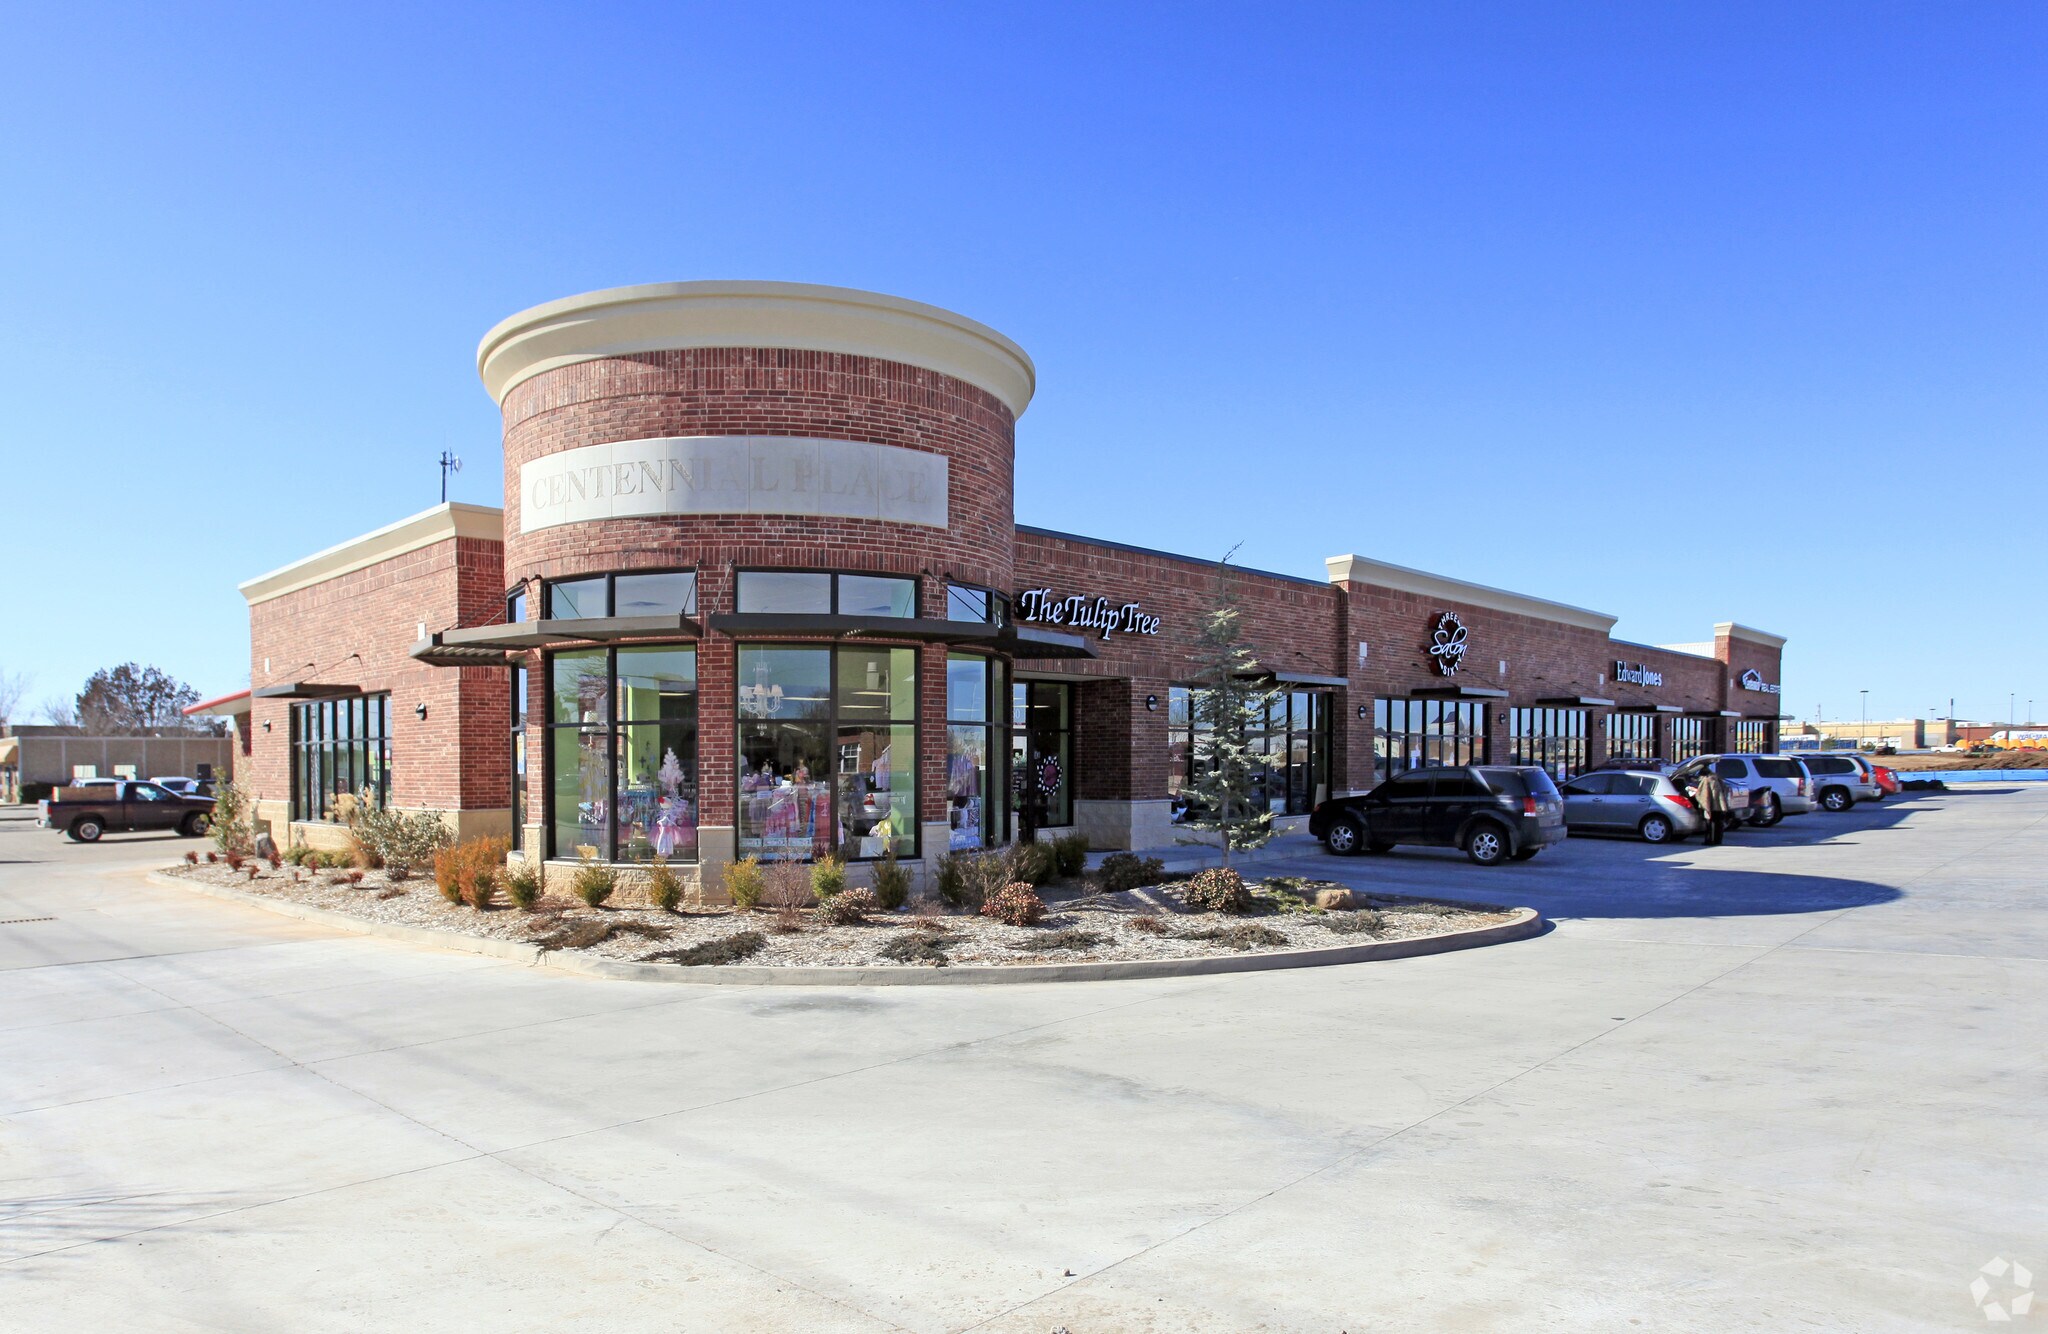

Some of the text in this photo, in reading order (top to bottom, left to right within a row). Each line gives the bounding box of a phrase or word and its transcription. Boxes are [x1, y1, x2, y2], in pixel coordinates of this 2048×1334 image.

[531, 455, 928, 510] CENTENNIAL PLACE
[1021, 588, 1161, 641] The Tulip Tree
[1438, 611, 1458, 630] THREE
[1430, 626, 1468, 659] Salon
[1616, 660, 1663, 688] Edward Jones
